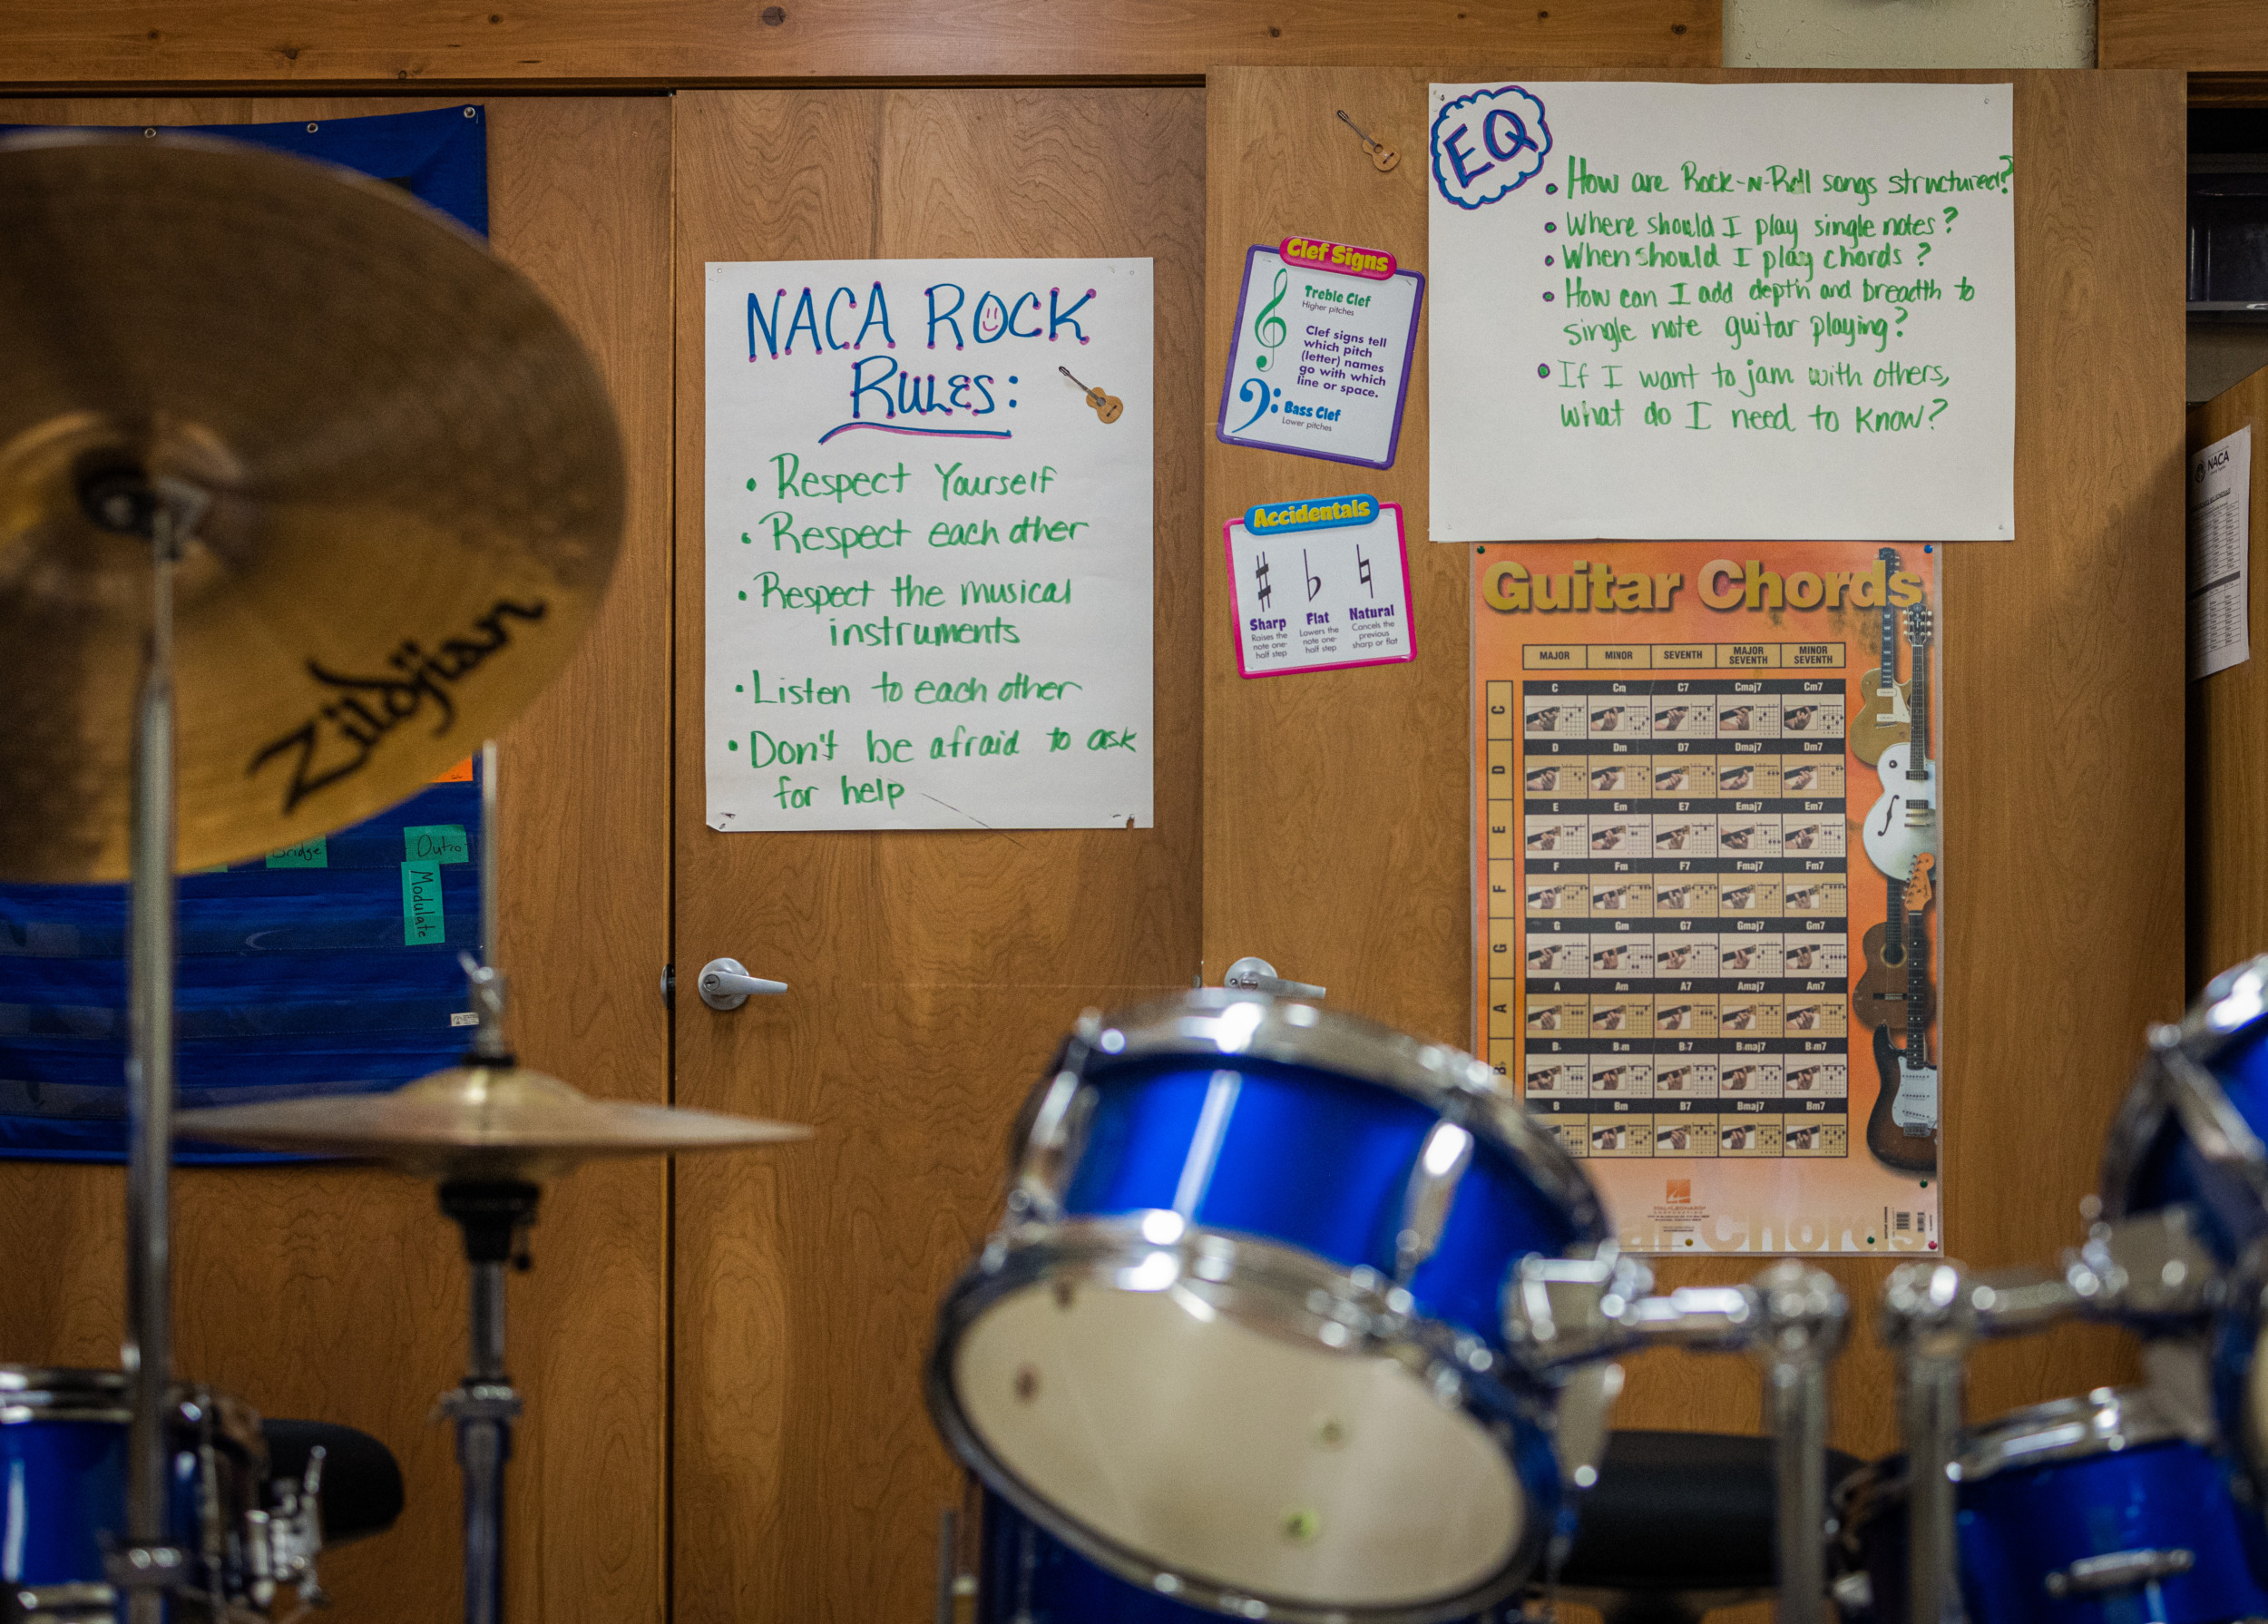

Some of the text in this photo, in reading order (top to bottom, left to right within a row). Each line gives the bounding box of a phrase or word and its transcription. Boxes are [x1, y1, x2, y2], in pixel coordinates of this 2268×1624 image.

[1443, 107, 1540, 190] EQ
[1567, 155, 1619, 200] How
[1631, 171, 1669, 193] are
[1823, 171, 1877, 206] songs
[1566, 210, 1637, 238] Where
[1647, 212, 1715, 239] should
[1722, 215, 1743, 238] I
[1755, 215, 1799, 246] play
[1814, 213, 1876, 249] single
[1286, 238, 1389, 272] Clef Signs
[1562, 243, 1630, 269] When
[1733, 247, 1754, 268] I
[1764, 248, 1813, 282] play
[1305, 285, 1373, 308] Treble Clef
[1565, 277, 1976, 309] How can I add depth and breadth to
[1302, 299, 1354, 317] Higher pitches
[747, 280, 1097, 362] NACA ROCK
[1563, 305, 1910, 353] single note guitar playing?
[1305, 325, 1387, 348] Clef signs tell
[1304, 339, 1373, 360] which pitch
[1301, 350, 1384, 374] (letter) names
[1299, 366, 1386, 386] go with which
[1558, 358, 1950, 398] If I want to jam with others,
[1296, 376, 1379, 399] line or space.
[1284, 401, 1342, 423] Bass Clef
[1559, 397, 1625, 428] what
[1645, 401, 1672, 427] do
[1685, 401, 1713, 430] I
[1732, 402, 1796, 433] need
[1808, 402, 1840, 432] to
[1282, 416, 1332, 432] Lower pitches
[2207, 450, 2229, 472] NACA
[769, 452, 1057, 504] Respect Yourself
[1254, 499, 1371, 528] Accidentals
[758, 511, 1089, 559] Respect each other
[1482, 559, 1924, 611] Guitar Chords
[753, 571, 1071, 615] Respect the musical
[1306, 611, 1330, 625] Flat
[1349, 604, 1394, 621] Natural
[1249, 617, 1286, 632] Sharp
[1352, 621, 1395, 632] Cancels the
[829, 615, 1021, 647] instruments
[1251, 631, 1288, 642] Raises the
[1299, 626, 1339, 638] Lowers the
[1359, 630, 1390, 641] previous
[1253, 642, 1270, 651] note
[1303, 637, 1319, 645] note
[1352, 640, 1374, 651] sharp
[1385, 637, 1398, 646] flat
[1305, 644, 1337, 654] half step
[1734, 646, 1764, 655] MAJOR
[1799, 645, 1828, 655] MINOR
[1256, 650, 1287, 660] half step
[1540, 651, 1570, 660] MAJOR
[1605, 651, 1633, 660] MINOR
[1664, 651, 1703, 660] SEVENTH
[1729, 655, 1768, 665] SEVENTH
[1794, 655, 1833, 664] SEVENTH
[752, 670, 1083, 705] Listen to each other
[1613, 683, 1627, 692] Cm
[1677, 683, 1689, 692] C7
[1735, 682, 1763, 692] Cmaj7
[1804, 682, 1823, 691] Cm7
[246, 599, 548, 817] Zildjian
[1491, 705, 1505, 715] C
[750, 726, 1138, 768] Don't be afraid to ask
[1613, 743, 1628, 752] Dm
[1678, 743, 1690, 752] D7
[1735, 742, 1763, 752] Dmaj7
[1804, 742, 1823, 751] Dm7
[1491, 765, 1505, 774] D
[773, 774, 905, 810] for help
[1735, 802, 1763, 812] Emaj7
[1804, 802, 1823, 811] Em7
[1492, 826, 1506, 834] E
[417, 834, 462, 857] Outro
[1736, 861, 1764, 872] Fmaj7
[1805, 861, 1824, 871] Fm7
[410, 870, 435, 938] Modulate
[1736, 921, 1765, 932] Gmaj7
[1805, 921, 1825, 931] Gm7
[1493, 944, 1507, 954] G
[1737, 981, 1765, 992] Amaj7
[1806, 981, 1825, 991] Am7
[1493, 1003, 1507, 1013] A
[1736, 1101, 1765, 1112] Bmaj7
[1806, 1101, 1825, 1111] Bm7
